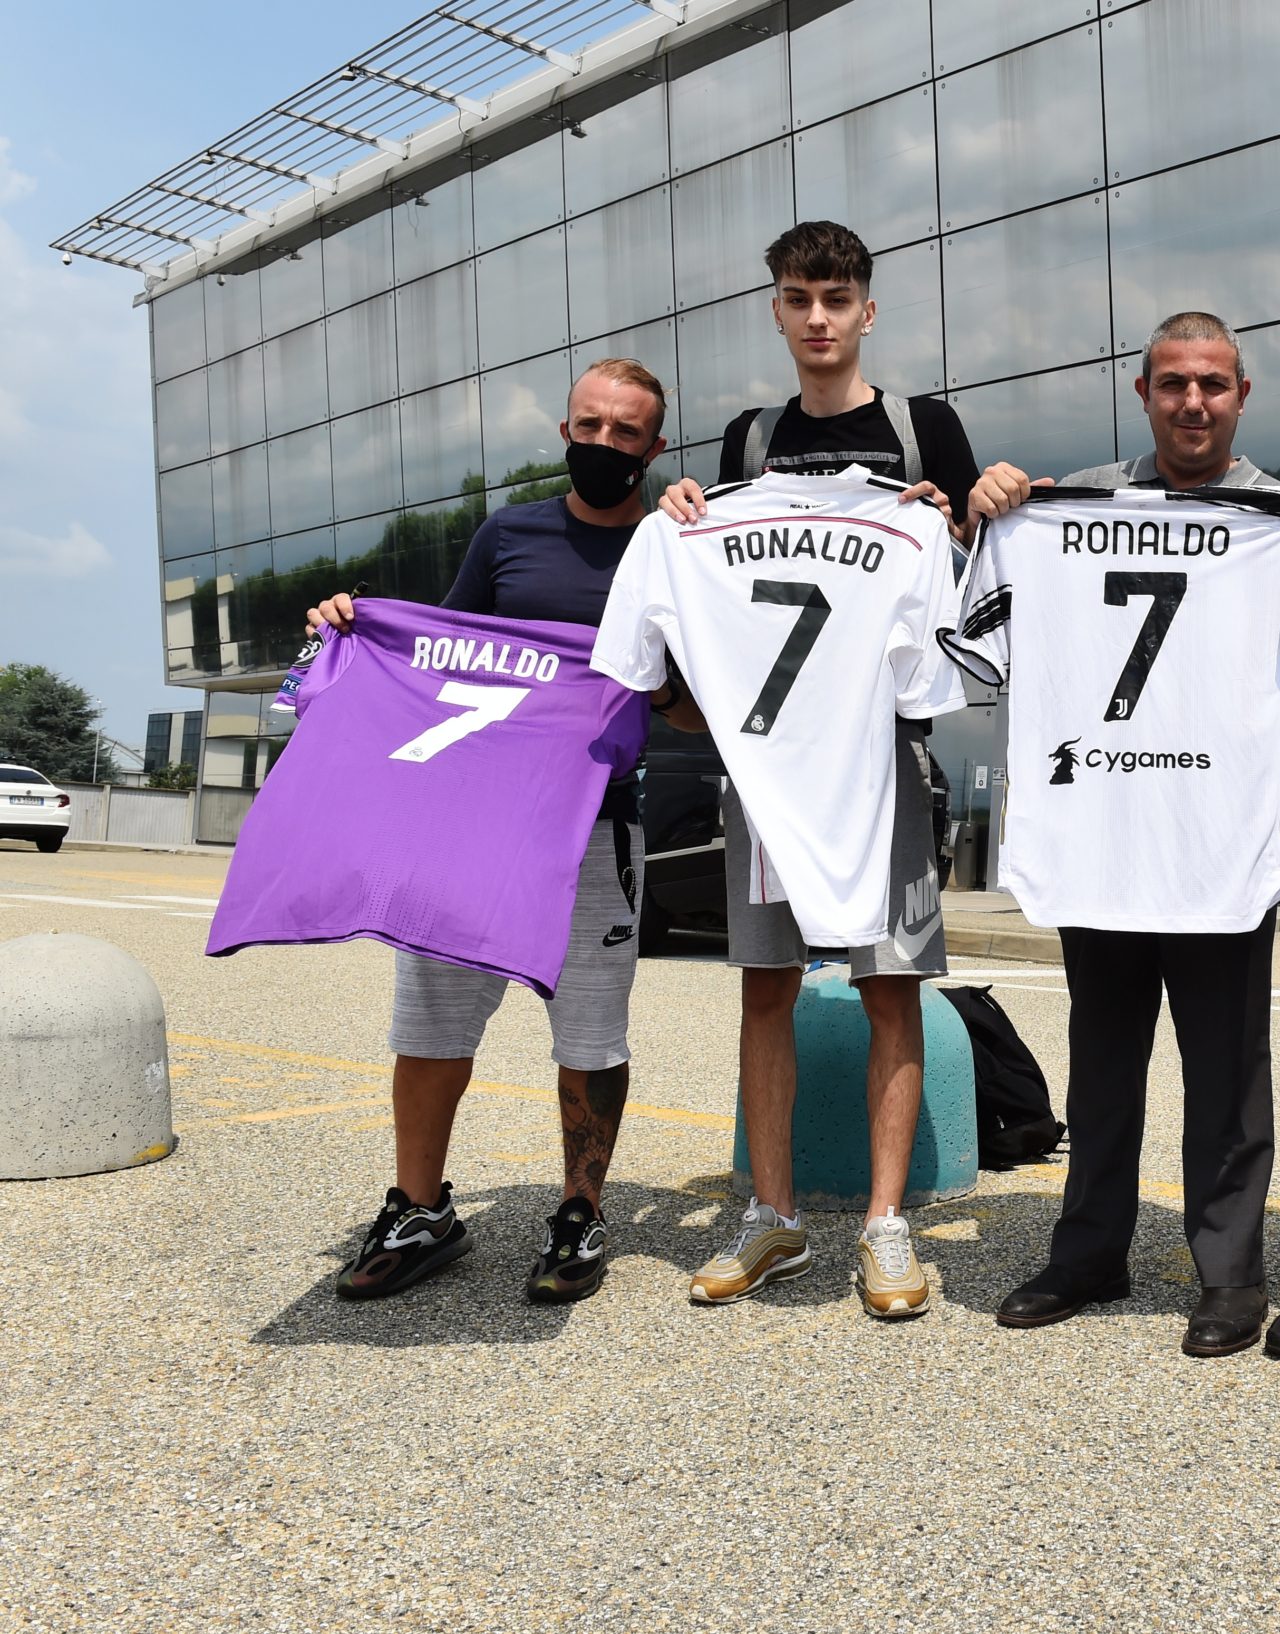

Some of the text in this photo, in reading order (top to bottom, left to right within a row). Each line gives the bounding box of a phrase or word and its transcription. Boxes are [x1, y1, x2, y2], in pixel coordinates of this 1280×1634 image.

[723, 527, 885, 574] RONALDO
[1062, 520, 1230, 557] RONALDO
[411, 636, 560, 683] RONALDO
[740, 579, 832, 736] 7
[1103, 571, 1188, 723] 7
[388, 680, 532, 764] 7
[1085, 748, 1211, 773] Cygames
[609, 925, 633, 937] NIKE
